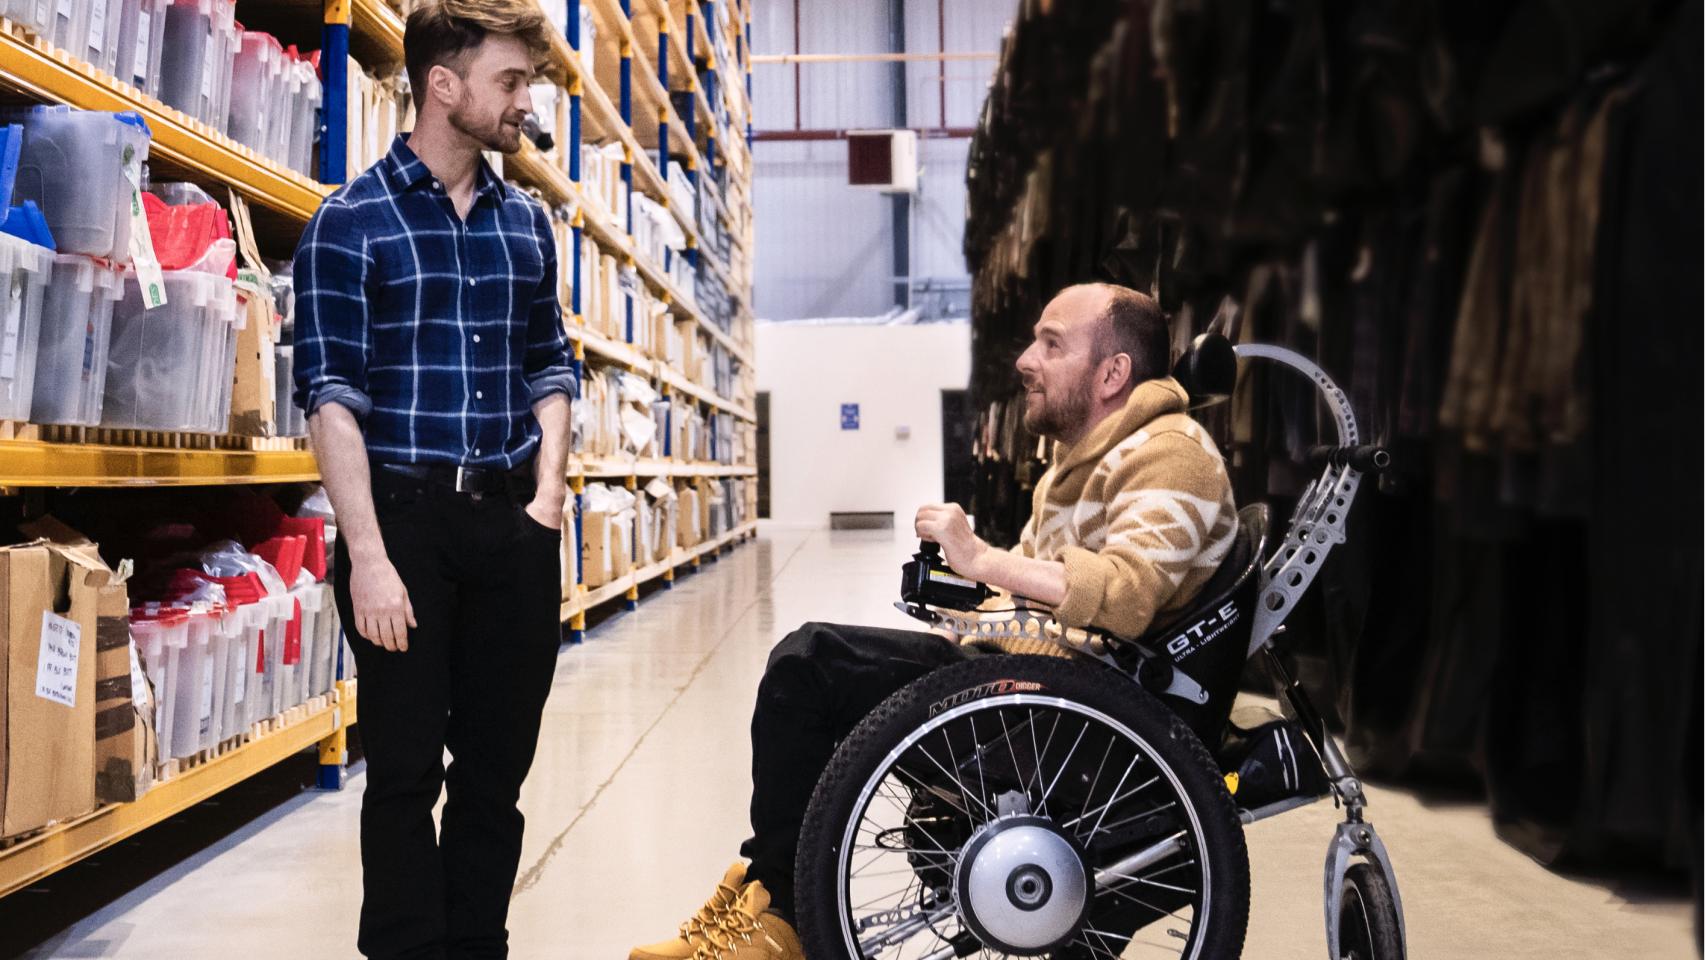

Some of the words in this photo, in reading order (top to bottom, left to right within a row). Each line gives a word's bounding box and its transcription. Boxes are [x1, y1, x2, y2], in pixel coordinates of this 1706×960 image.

[1167, 600, 1238, 655] GT-E
[1174, 646, 1196, 663] ULTRA
[1200, 612, 1240, 646] LIGHTWEIGHT
[929, 680, 1015, 719] MOTO
[1015, 681, 1041, 692] DIGGER
